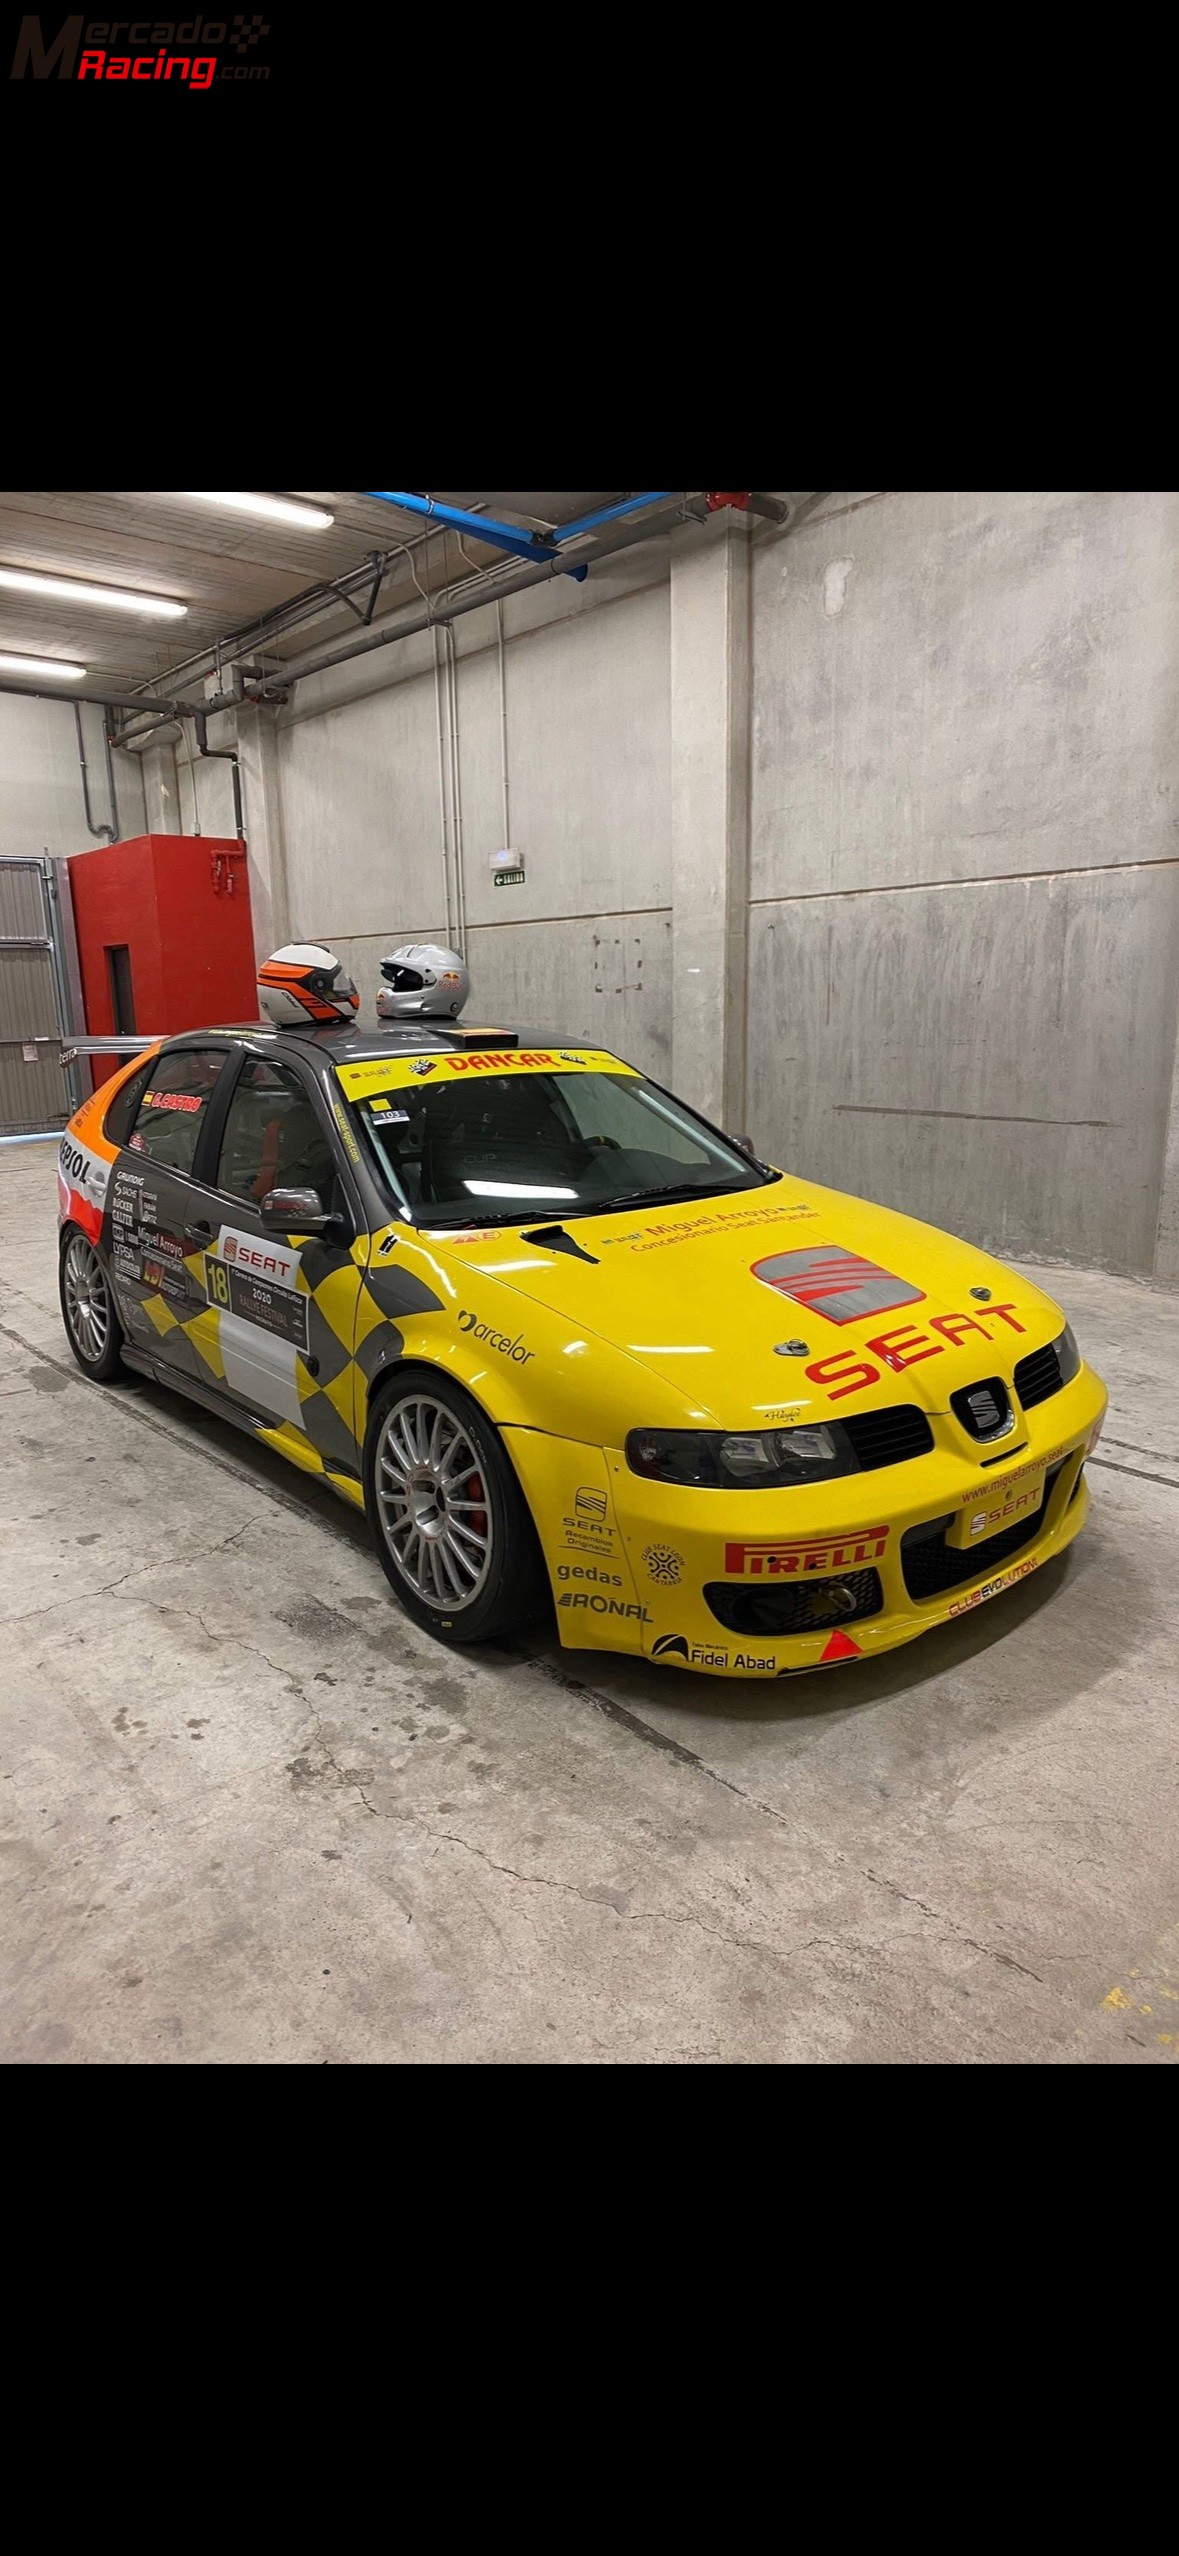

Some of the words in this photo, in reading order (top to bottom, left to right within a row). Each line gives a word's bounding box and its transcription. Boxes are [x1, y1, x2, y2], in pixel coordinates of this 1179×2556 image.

[445, 1053, 562, 1072] DANCAR
[380, 1111, 401, 1119] 103
[464, 1153, 496, 1164] CUP
[116, 1171, 145, 1187] GRUNDIG
[645, 1216, 715, 1236] Miguel
[715, 1207, 780, 1222] Arroyo
[138, 1225, 160, 1247] Miguel
[160, 1236, 183, 1259] Arroyo
[630, 1225, 729, 1252] Concesionario
[728, 1218, 757, 1230] Seat
[239, 1247, 290, 1277] SEAT
[208, 1263, 229, 1304] 18
[252, 1287, 272, 1305] 2020
[473, 1323, 536, 1365] arcelor
[804, 1303, 1027, 1401] SEAT
[988, 1487, 1041, 1523] SEAT
[562, 1517, 617, 1537] SEAT
[565, 1530, 614, 1547] Recambios
[567, 1538, 612, 1554] Originales
[725, 1525, 890, 1573] PIRELLI
[557, 1564, 623, 1587] gedas
[572, 1593, 654, 1623] RONAL
[691, 1649, 728, 1667] Fidel
[733, 1654, 776, 1670] Abad
